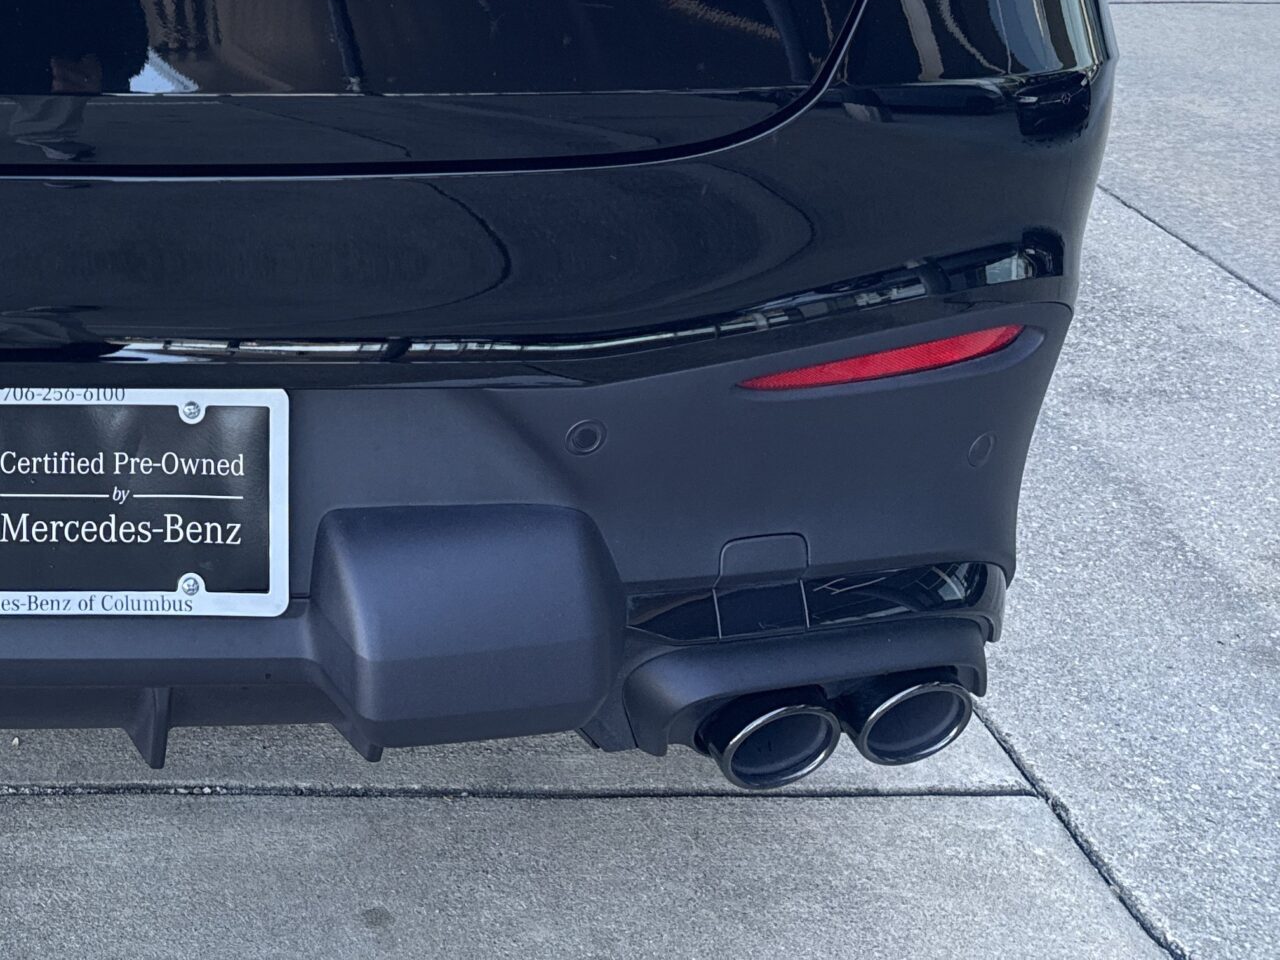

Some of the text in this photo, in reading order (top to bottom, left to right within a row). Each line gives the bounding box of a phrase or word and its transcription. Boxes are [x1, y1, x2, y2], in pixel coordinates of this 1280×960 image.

[0, 451, 245, 476] Certified Pre-Owned
[112, 486, 130, 504] by
[0, 513, 242, 545] Mercedes-Benz
[79, 594, 97, 612] of
[101, 594, 193, 612] Columbus
